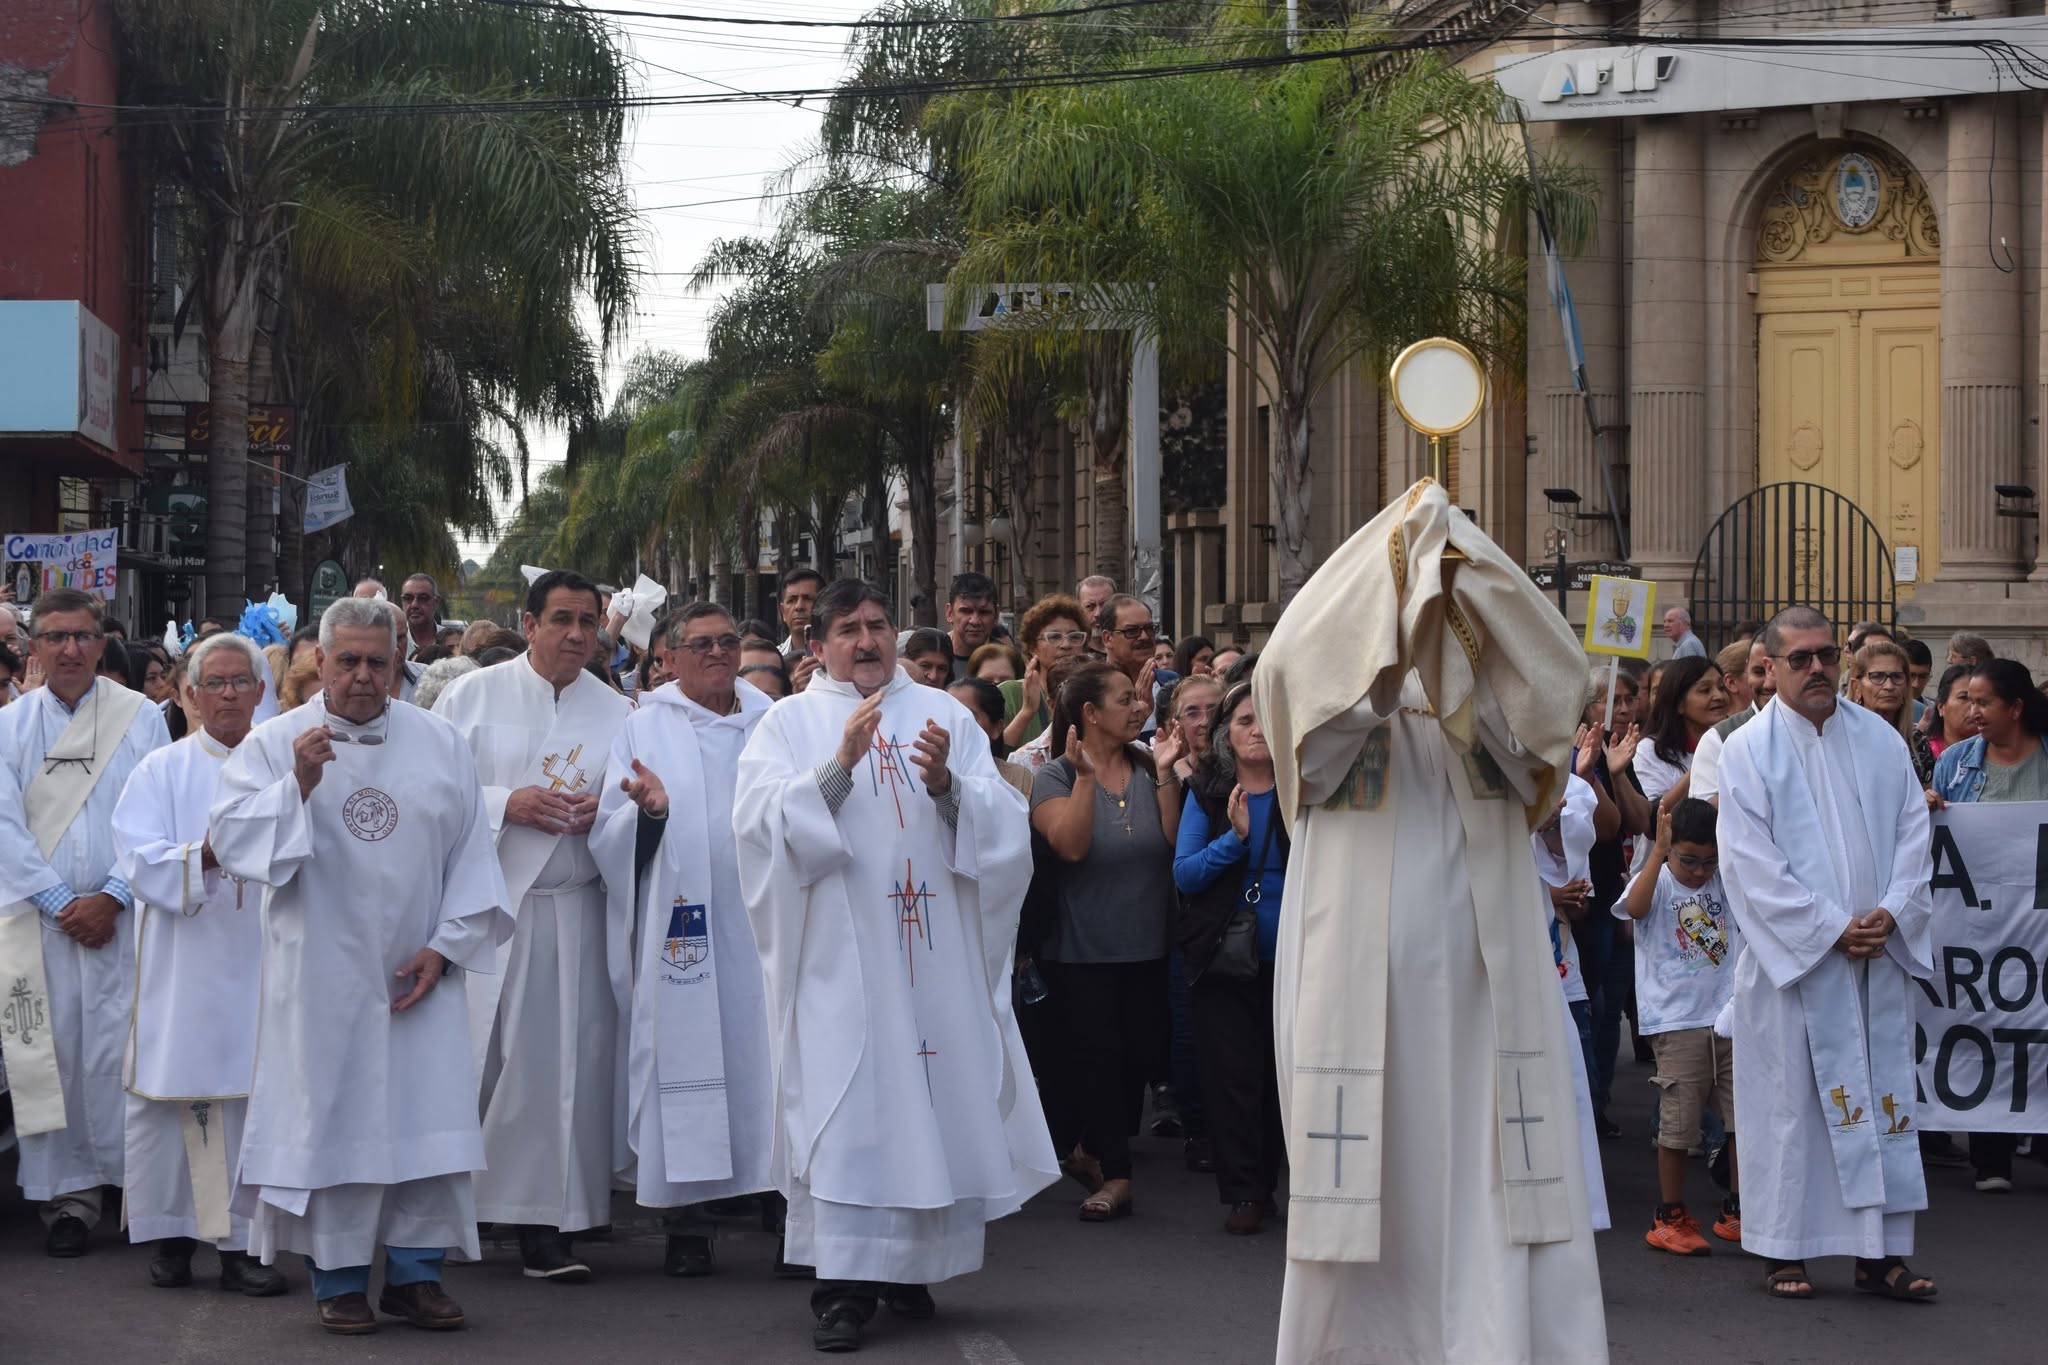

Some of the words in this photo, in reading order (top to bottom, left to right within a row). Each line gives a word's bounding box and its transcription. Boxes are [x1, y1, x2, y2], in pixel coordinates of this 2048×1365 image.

[1538, 55, 1679, 103] AFIP
[184, 557, 206, 566] Mar
[381, 796, 393, 805] DE
